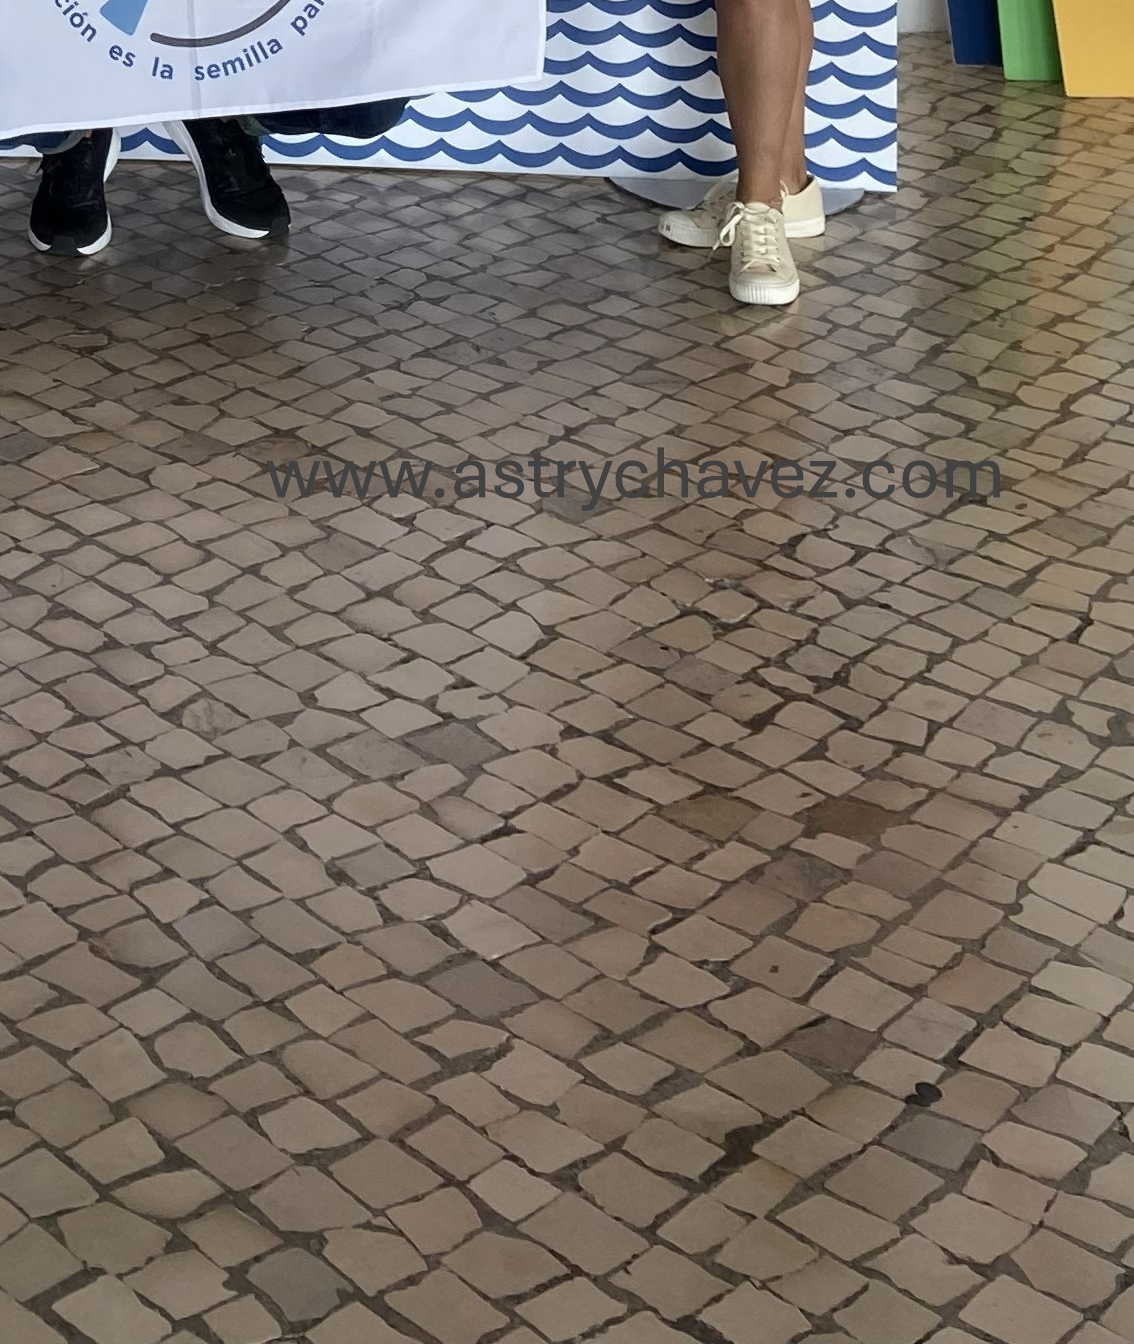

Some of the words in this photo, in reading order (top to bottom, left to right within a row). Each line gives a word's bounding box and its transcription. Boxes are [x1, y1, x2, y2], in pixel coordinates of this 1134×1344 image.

[108, 44, 137, 68] es
[151, 56, 174, 80] la
[194, 37, 284, 81] semilla
